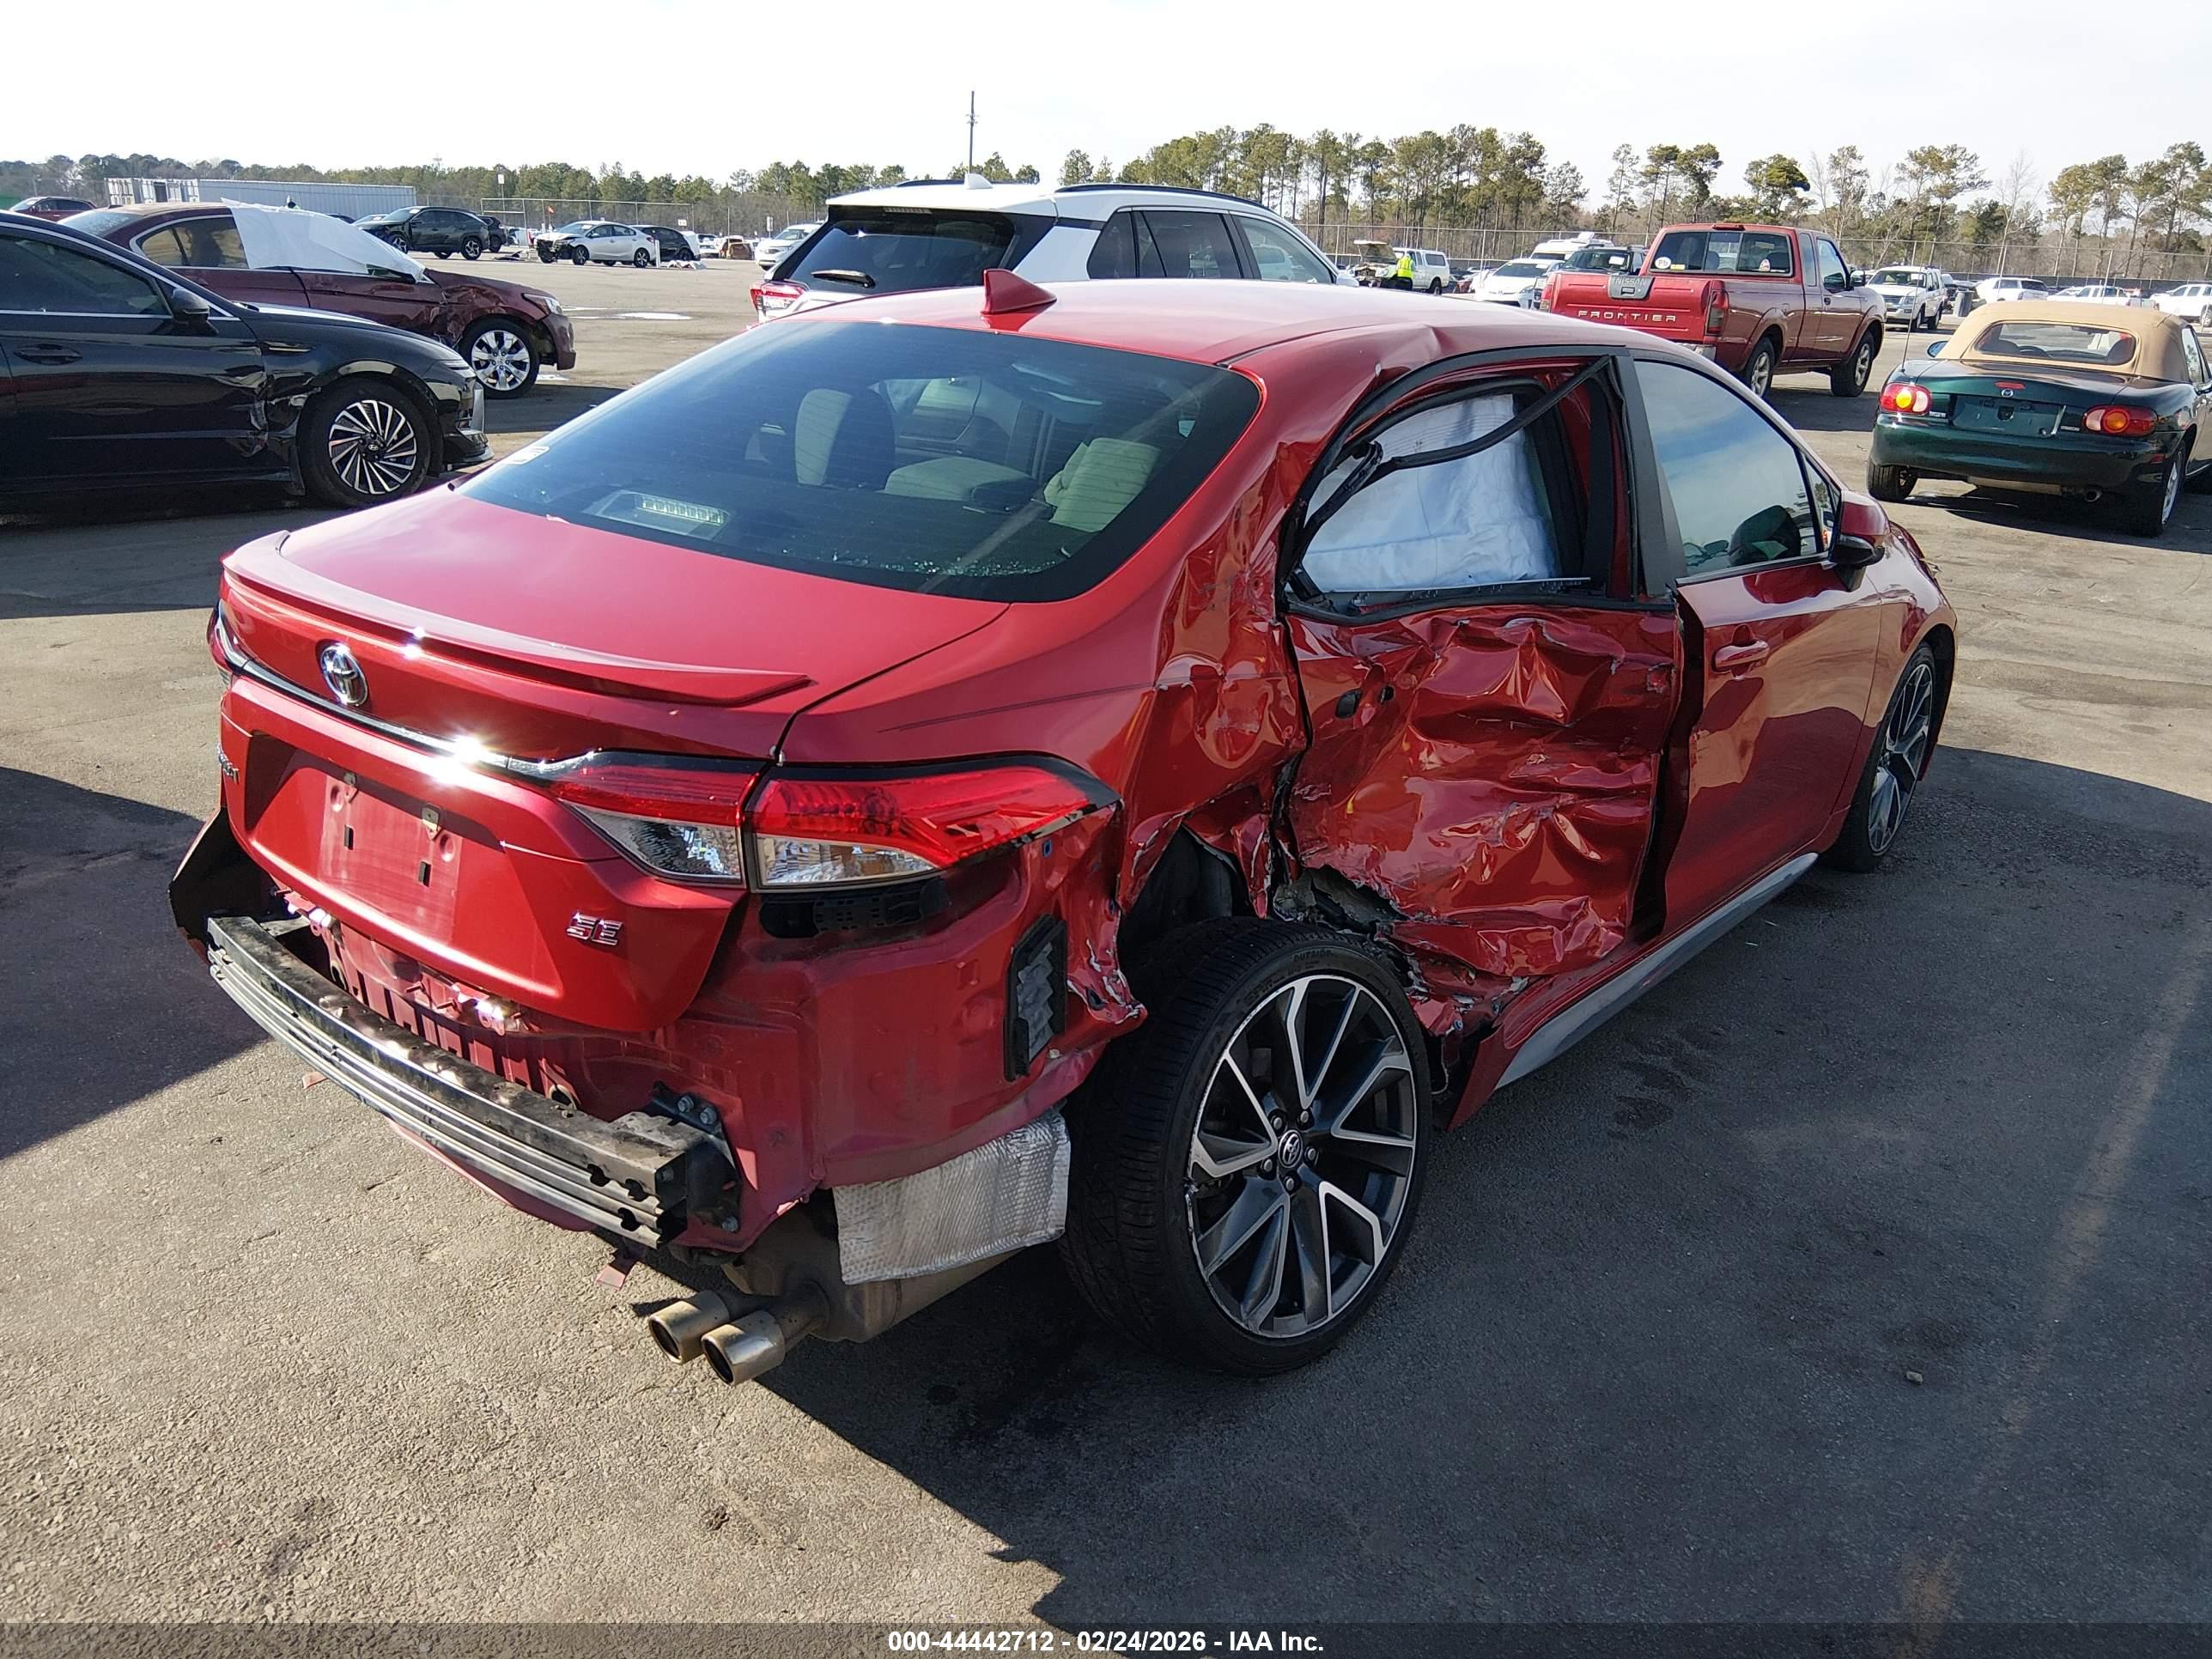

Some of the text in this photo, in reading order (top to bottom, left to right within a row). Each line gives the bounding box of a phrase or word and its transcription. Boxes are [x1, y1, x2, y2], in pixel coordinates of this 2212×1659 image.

[1613, 276, 1647, 285] NISSAN
[1577, 310, 1676, 323] FRONTIER
[567, 912, 623, 945] SE
